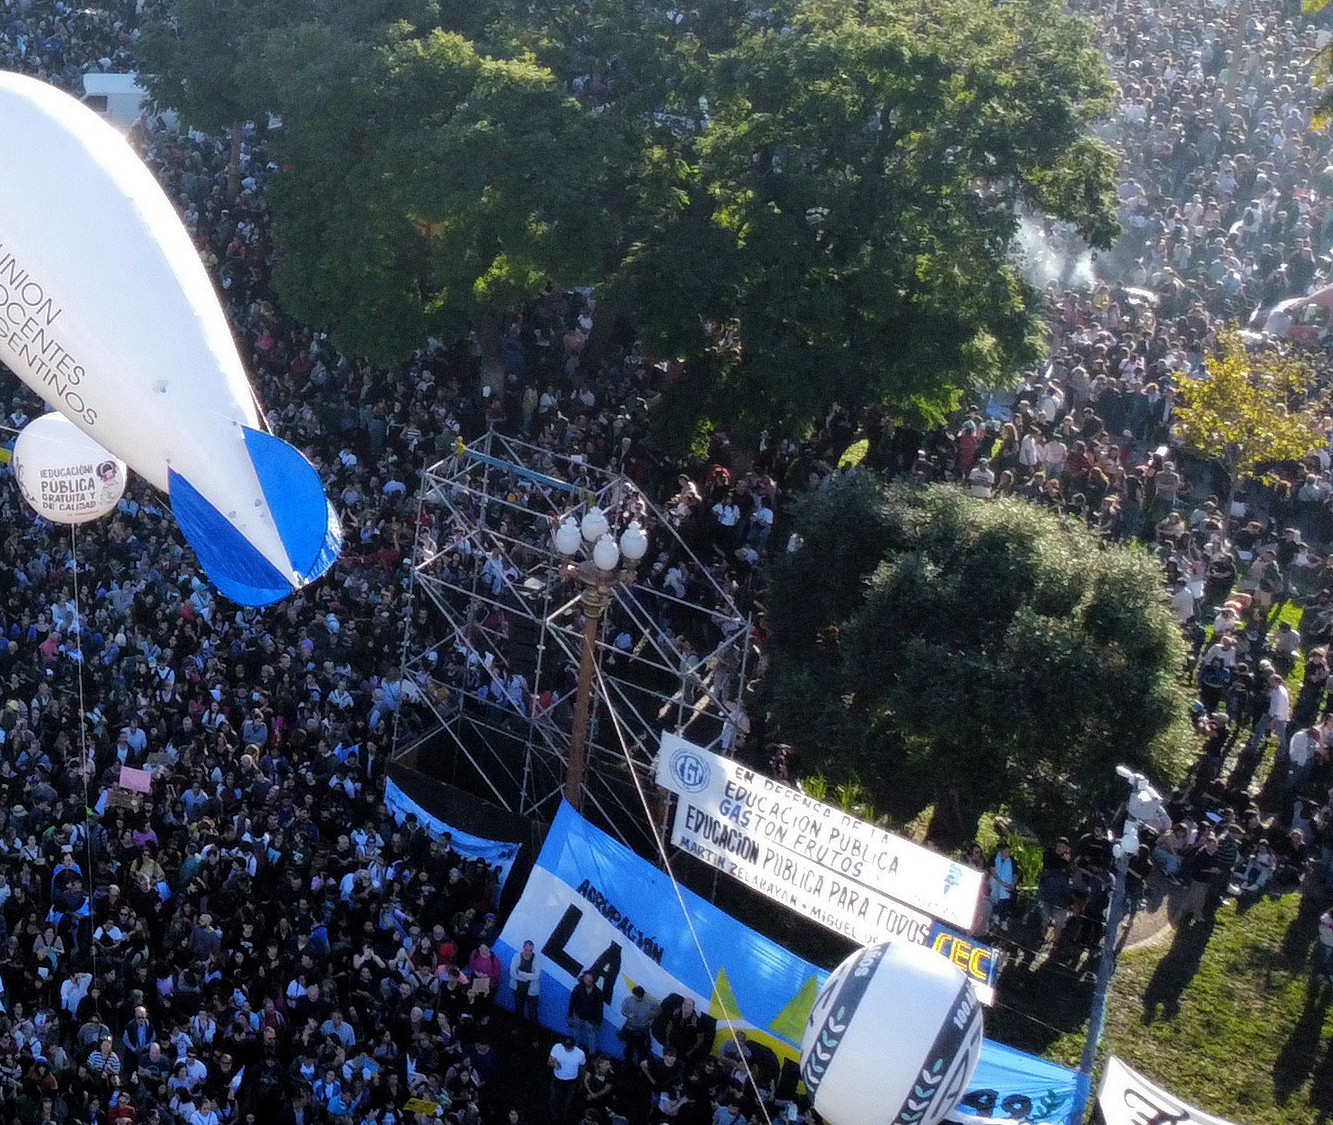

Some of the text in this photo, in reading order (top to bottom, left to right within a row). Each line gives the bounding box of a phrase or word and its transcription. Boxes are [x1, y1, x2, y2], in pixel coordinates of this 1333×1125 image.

[42, 491, 95, 503] GRATUITA Y
[43, 501, 96, 511] DE CALIDAD
[719, 798, 864, 877] GASTON FRUTOS
[828, 881, 871, 917] PARA
[876, 904, 932, 947] TODOS
